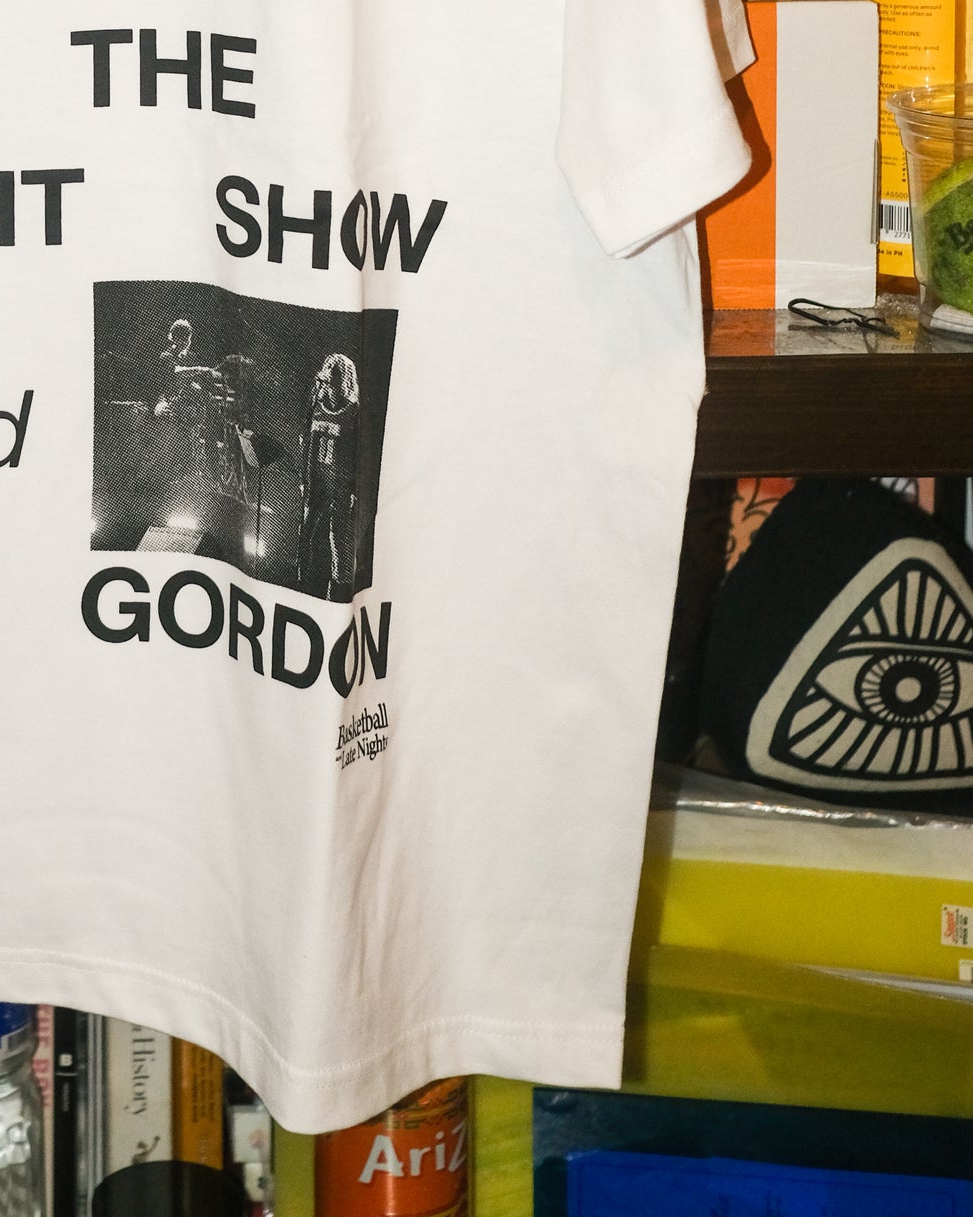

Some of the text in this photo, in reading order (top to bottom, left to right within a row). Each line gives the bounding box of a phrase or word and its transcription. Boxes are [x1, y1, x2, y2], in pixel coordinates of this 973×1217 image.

[70, 28, 258, 120] THE
[215, 175, 448, 274] SHOW
[80, 566, 392, 700] GORDON
[336, 702, 388, 750] Basketball
[123, 1038, 156, 1115] History
